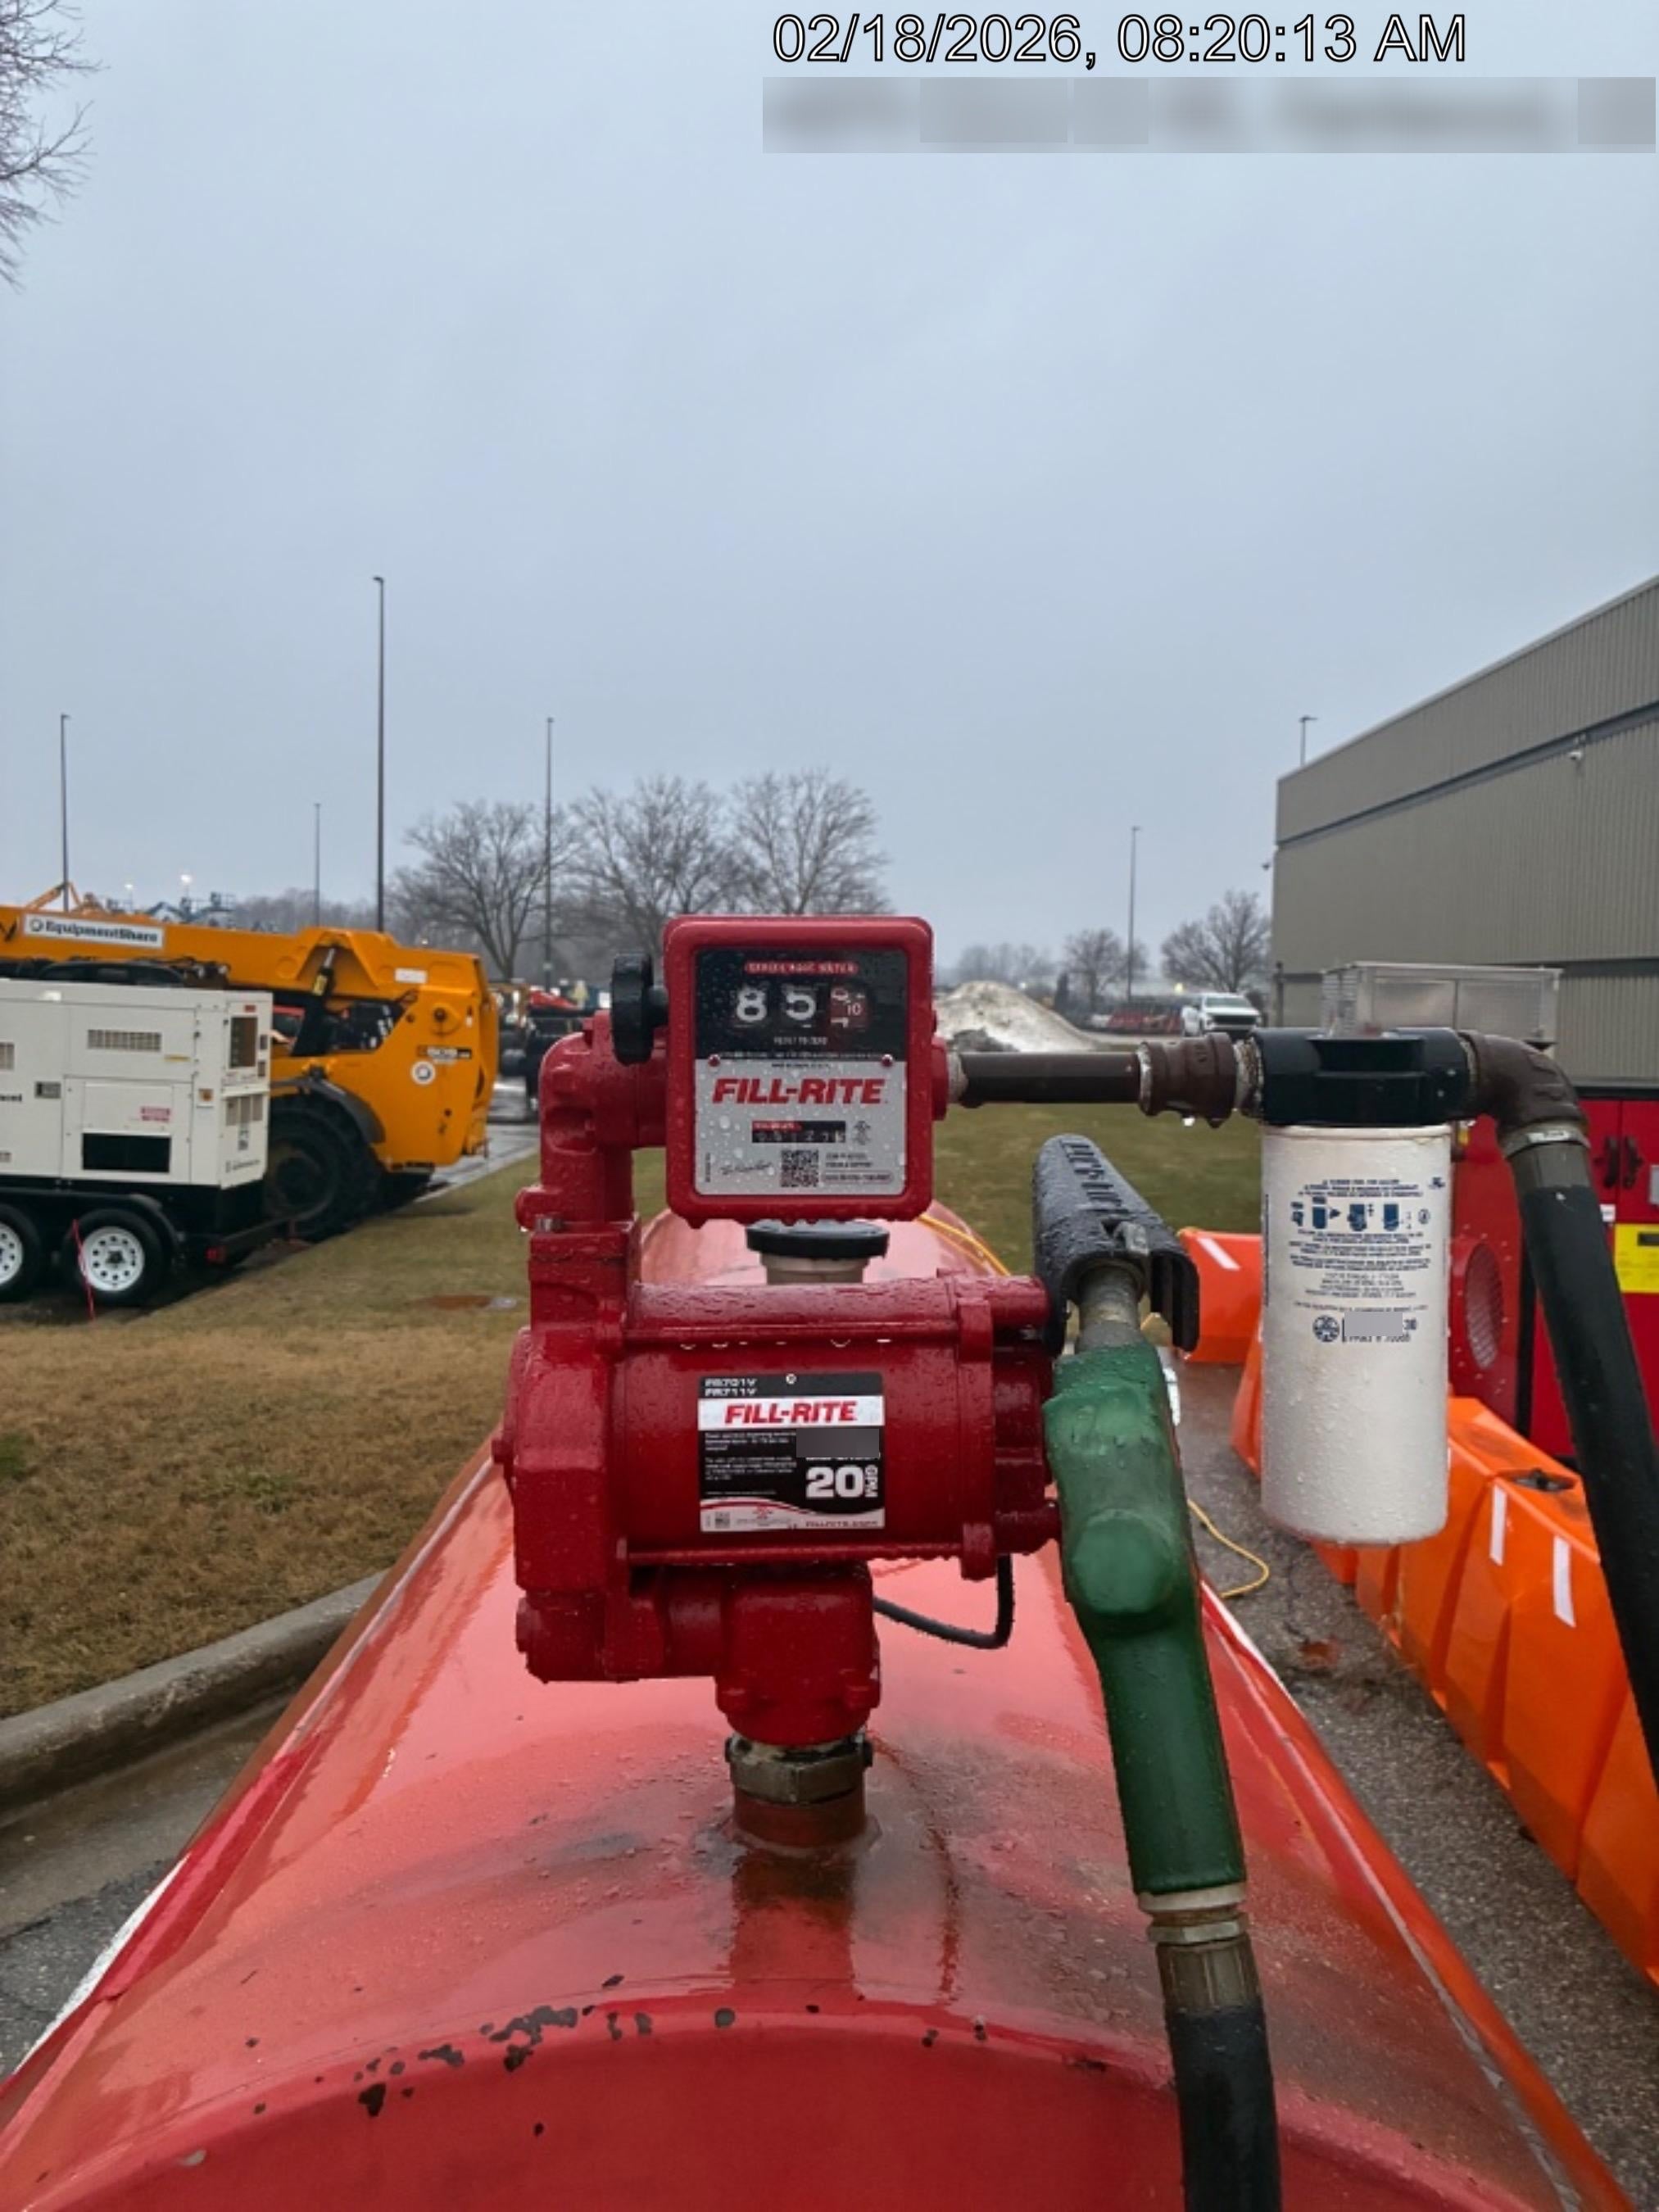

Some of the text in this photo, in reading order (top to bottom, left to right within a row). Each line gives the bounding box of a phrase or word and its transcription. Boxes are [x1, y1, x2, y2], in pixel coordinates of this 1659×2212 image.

[712, 1078, 885, 1104] FILL-RITE
[724, 1401, 857, 1424] FILL-RITE
[806, 1465, 863, 1498] 20
